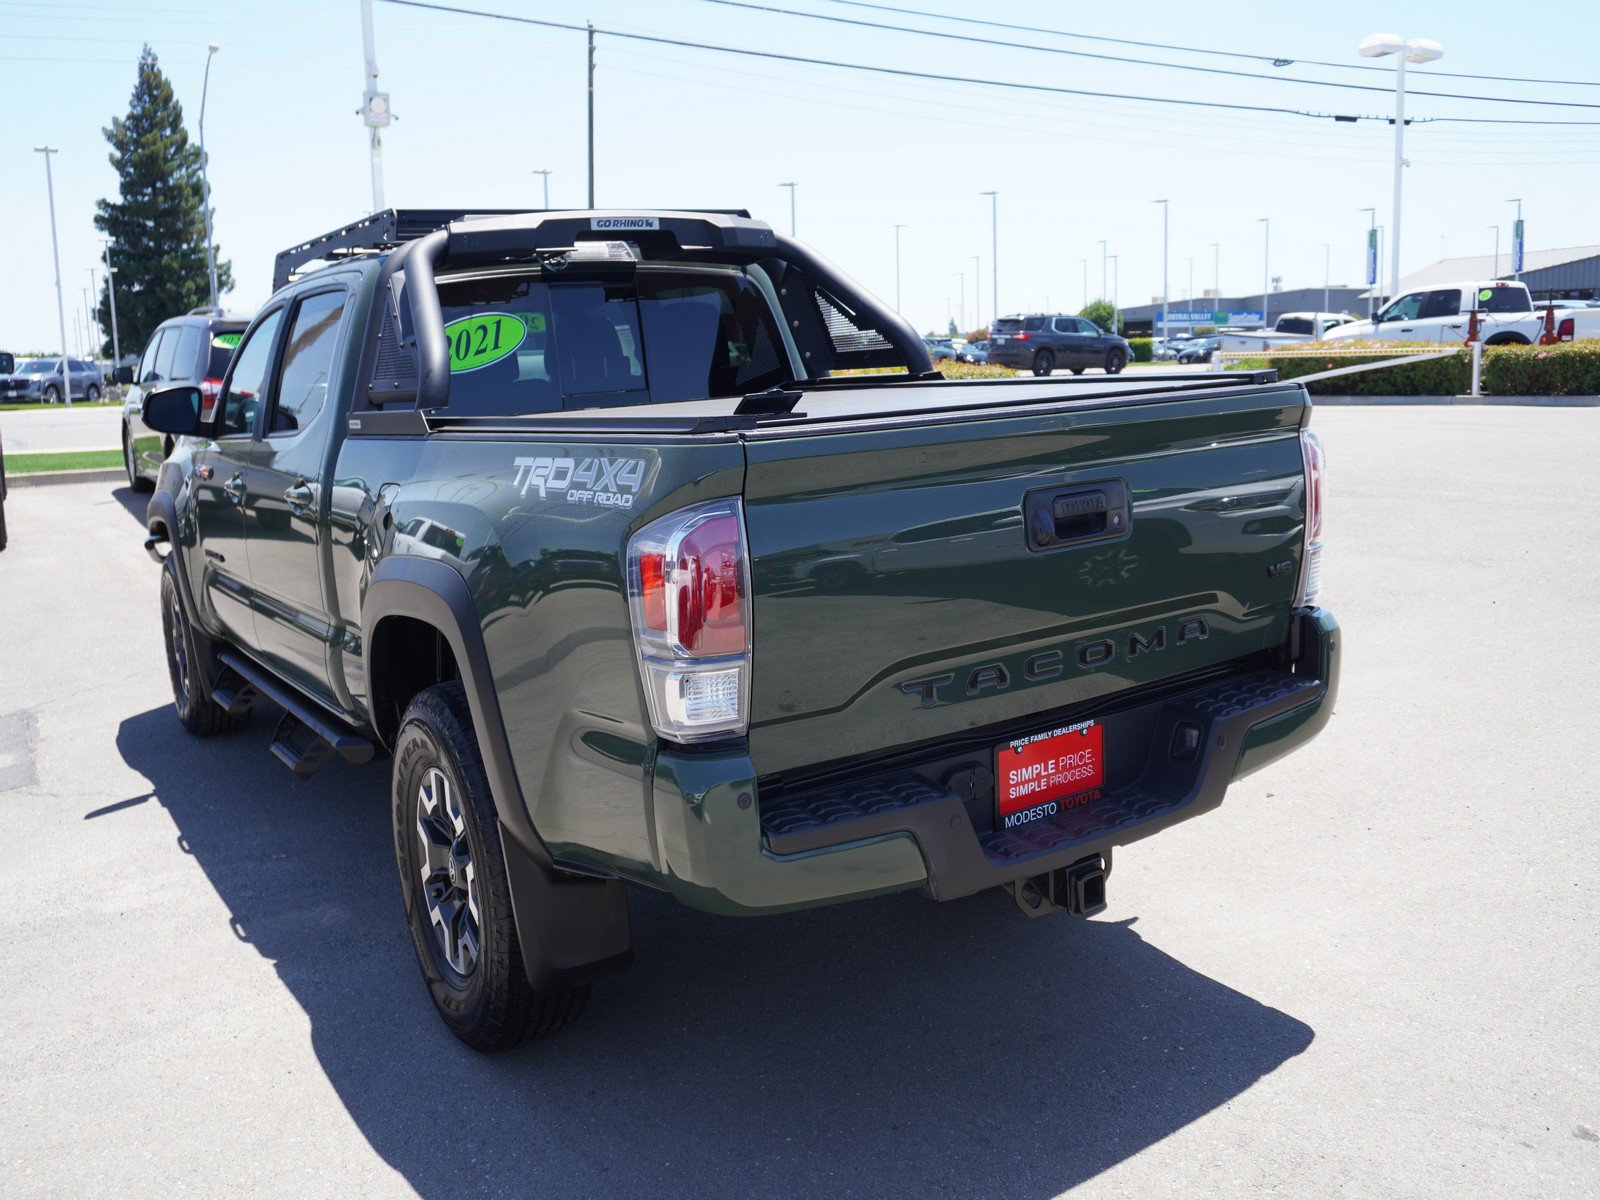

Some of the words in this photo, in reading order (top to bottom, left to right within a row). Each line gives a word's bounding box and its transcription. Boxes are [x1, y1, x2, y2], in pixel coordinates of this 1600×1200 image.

[1190, 312, 1212, 321] VALLEY
[513, 456, 575, 501] TRD
[572, 457, 646, 492] 4X4
[566, 490, 593, 505] OFF
[593, 491, 633, 510] ROAD
[1060, 497, 1105, 514] TOYOTA
[1267, 560, 1292, 577] V6
[902, 614, 1209, 709] TACOMA
[1009, 737, 1029, 748] PRICE
[1030, 730, 1053, 743] FAMILY
[1053, 719, 1095, 737] DEALERSHIPS
[1009, 759, 1056, 785] SIMPLE
[1059, 749, 1095, 770] PRICE.
[1009, 778, 1047, 799] SIMPLE
[1049, 765, 1095, 787] PROCESS.
[1005, 802, 1057, 829] MODESTO
[1060, 789, 1101, 811] TOYOTA
